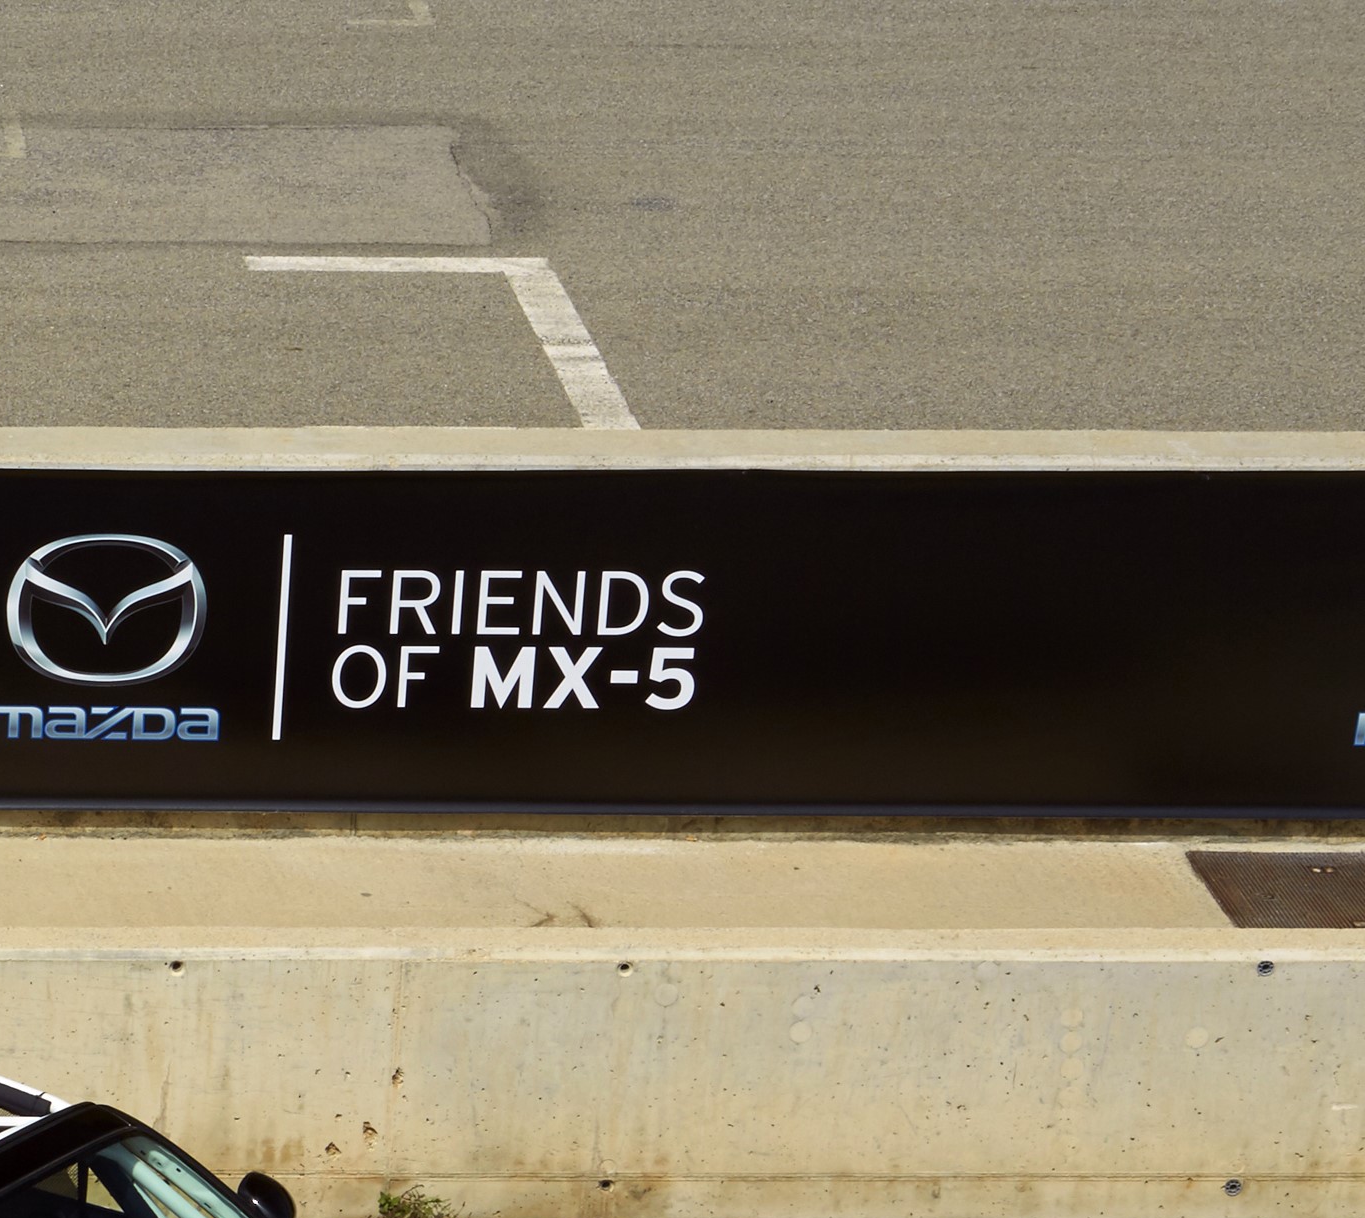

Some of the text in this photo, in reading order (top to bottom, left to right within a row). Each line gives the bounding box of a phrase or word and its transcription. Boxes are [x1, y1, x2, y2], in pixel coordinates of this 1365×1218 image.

[337, 569, 706, 638] FRIENDS
[330, 645, 696, 711] OF MX-5
